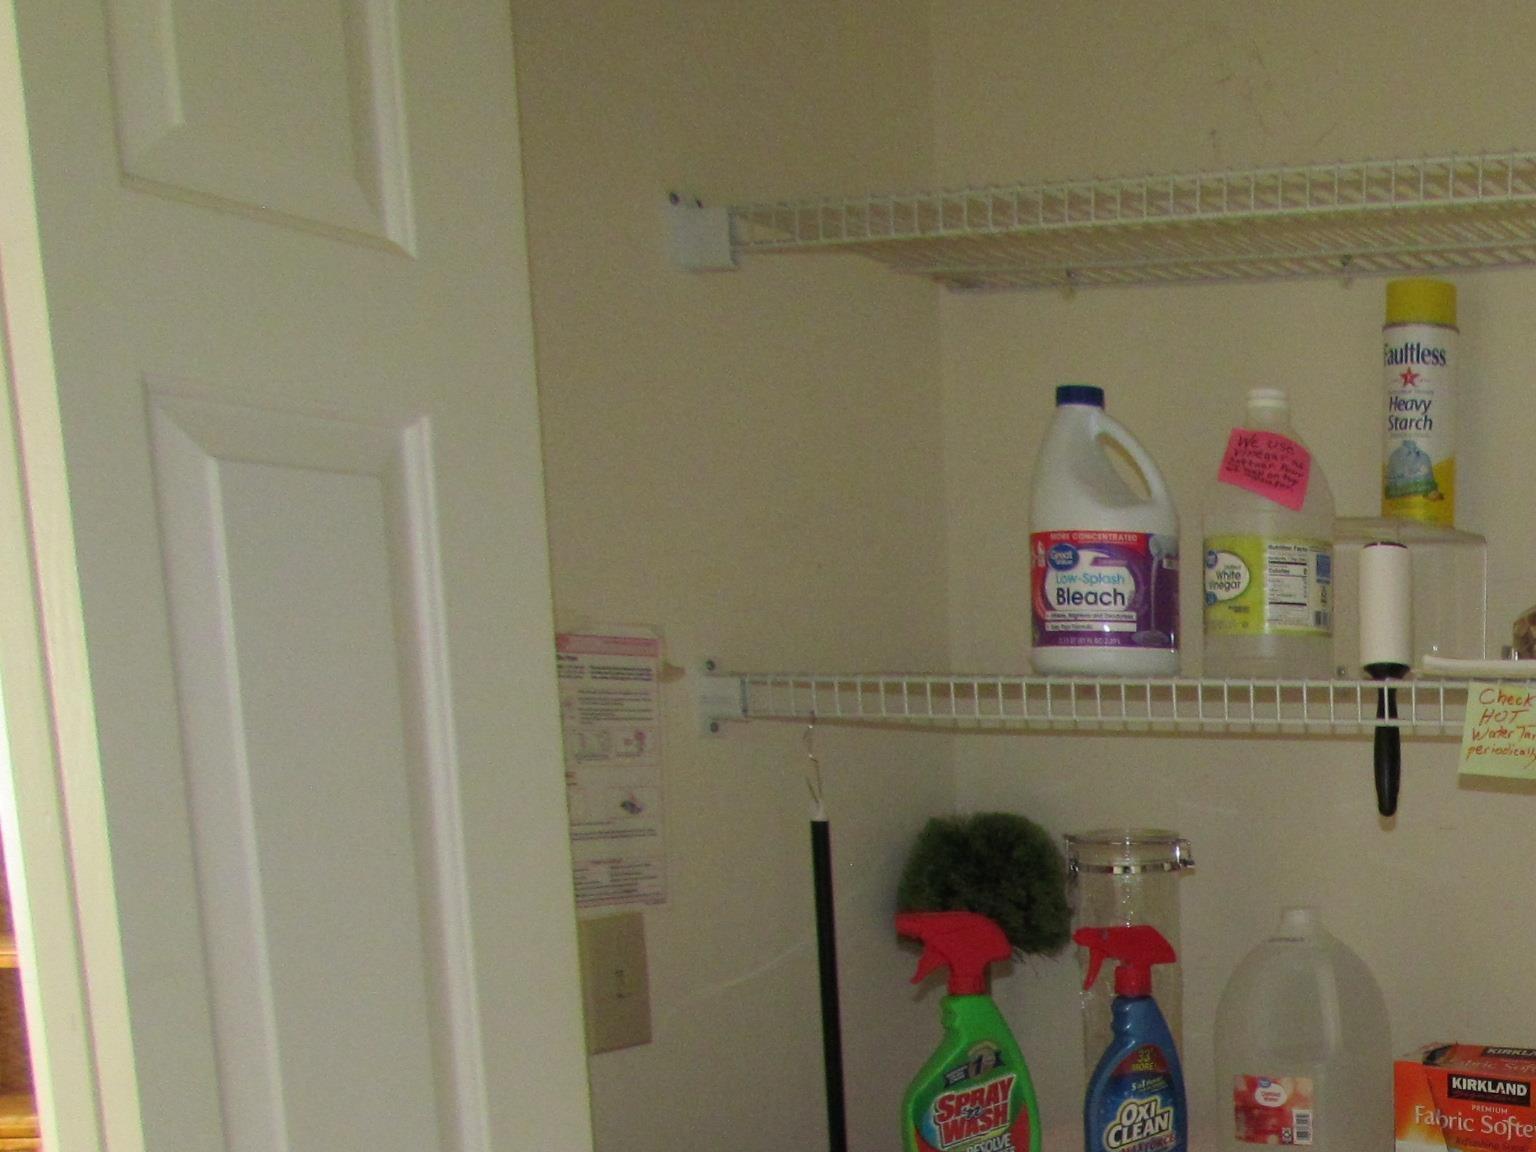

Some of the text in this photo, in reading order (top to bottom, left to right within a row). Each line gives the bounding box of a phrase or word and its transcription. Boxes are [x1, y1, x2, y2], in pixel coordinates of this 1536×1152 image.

[1389, 396, 1432, 415] Heavy
[1388, 415, 1433, 432] Starch
[1072, 532, 1138, 543] CONCENTRATED
[1056, 572, 1125, 587] Low-Splash
[1216, 569, 1242, 580] White
[1056, 587, 1126, 606] Bleach
[1478, 688, 1536, 707] Check
[1479, 708, 1530, 726] HOT
[1472, 725, 1515, 741] Water
[1451, 1077, 1528, 1097] KIRKLAND
[935, 1074, 1016, 1123] SPRAY
[1121, 1099, 1158, 1127] OXI
[1471, 1104, 1508, 1114] PREMIUM
[940, 1102, 1010, 1147] WASH
[1415, 1105, 1475, 1133] Fabric
[1108, 1111, 1171, 1149] CLEAN
